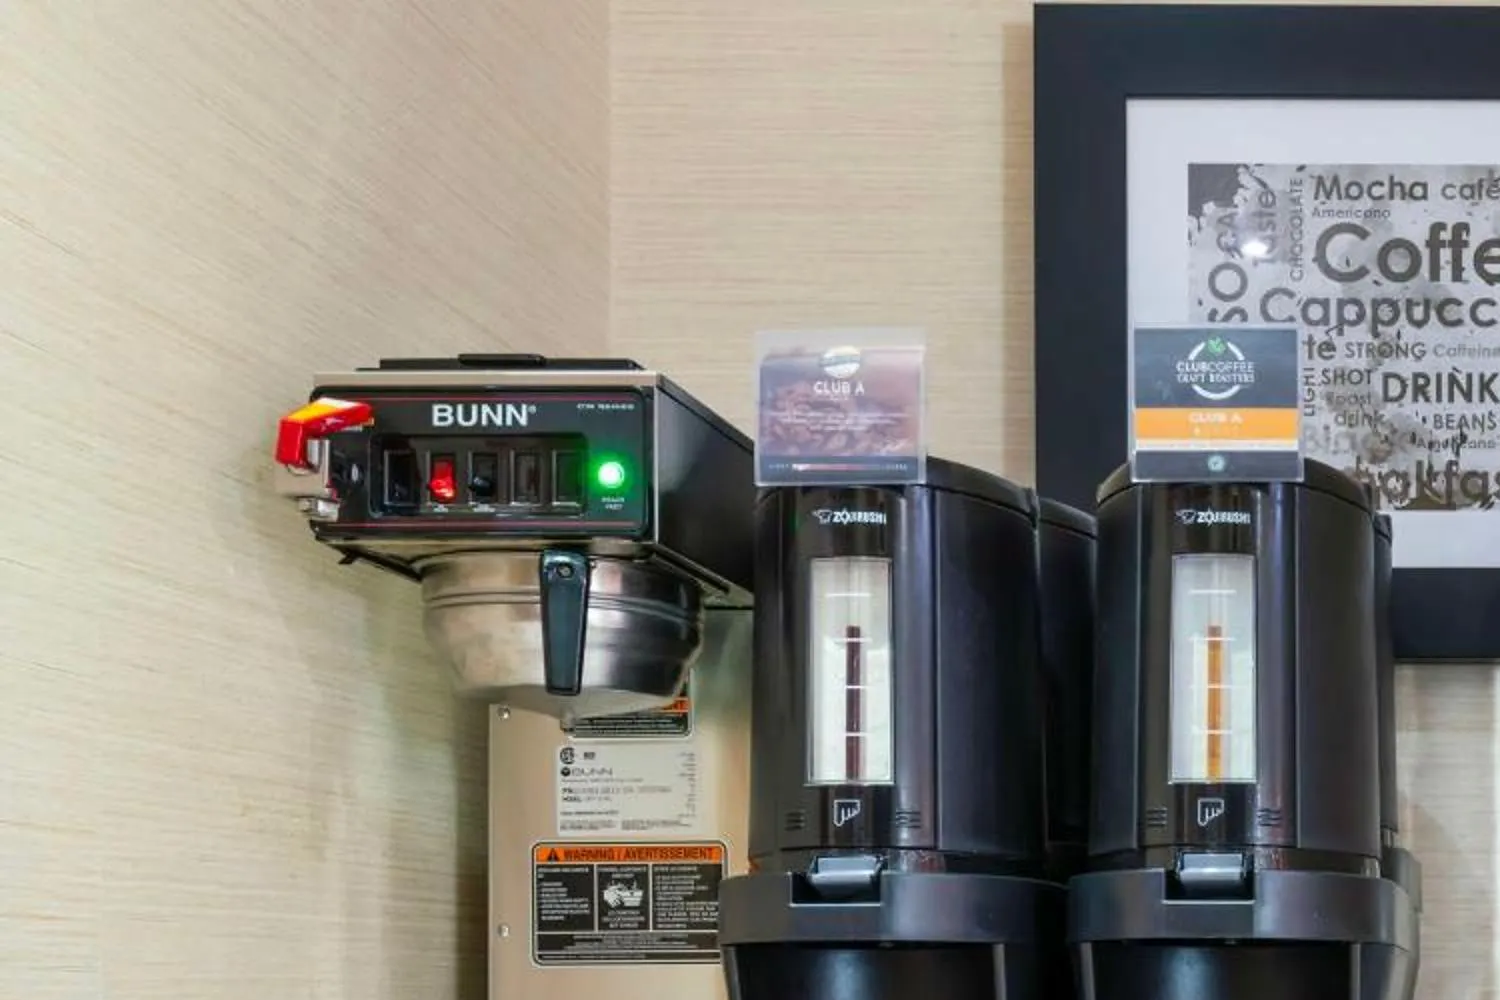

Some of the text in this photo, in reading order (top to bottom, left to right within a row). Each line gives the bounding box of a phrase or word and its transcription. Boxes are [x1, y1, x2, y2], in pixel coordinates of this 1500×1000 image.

[1312, 174, 1429, 201] Mocha
[1311, 206, 1391, 220] Americano
[1344, 341, 1427, 361] STRONG
[1321, 367, 1373, 386] SHOT
[813, 381, 865, 395] CLUB A
[1382, 371, 1500, 404] DRINK
[1433, 413, 1498, 431] BEANS
